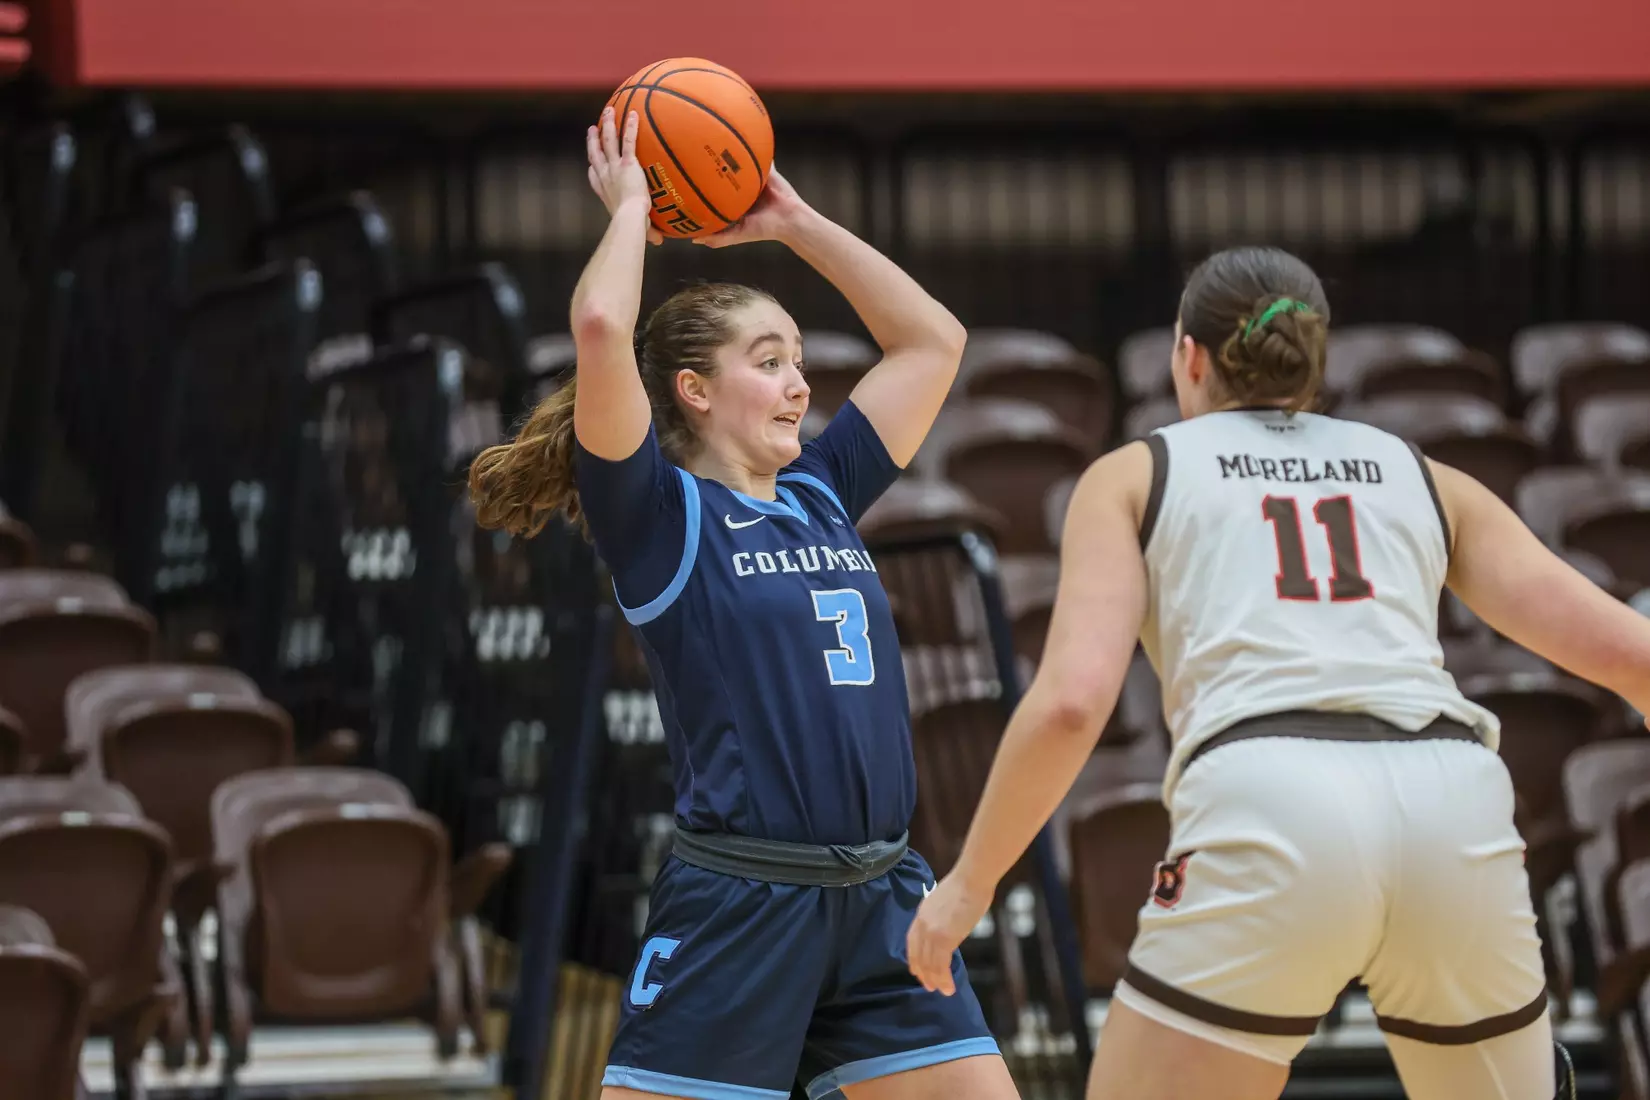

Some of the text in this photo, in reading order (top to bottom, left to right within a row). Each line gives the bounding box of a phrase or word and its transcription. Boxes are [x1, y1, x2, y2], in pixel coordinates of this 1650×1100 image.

[642, 165, 704, 235] ELITE
[1216, 453, 1383, 484] MORELAND
[1261, 493, 1376, 603] 11
[810, 588, 875, 685] 3
[629, 935, 682, 1006] C
